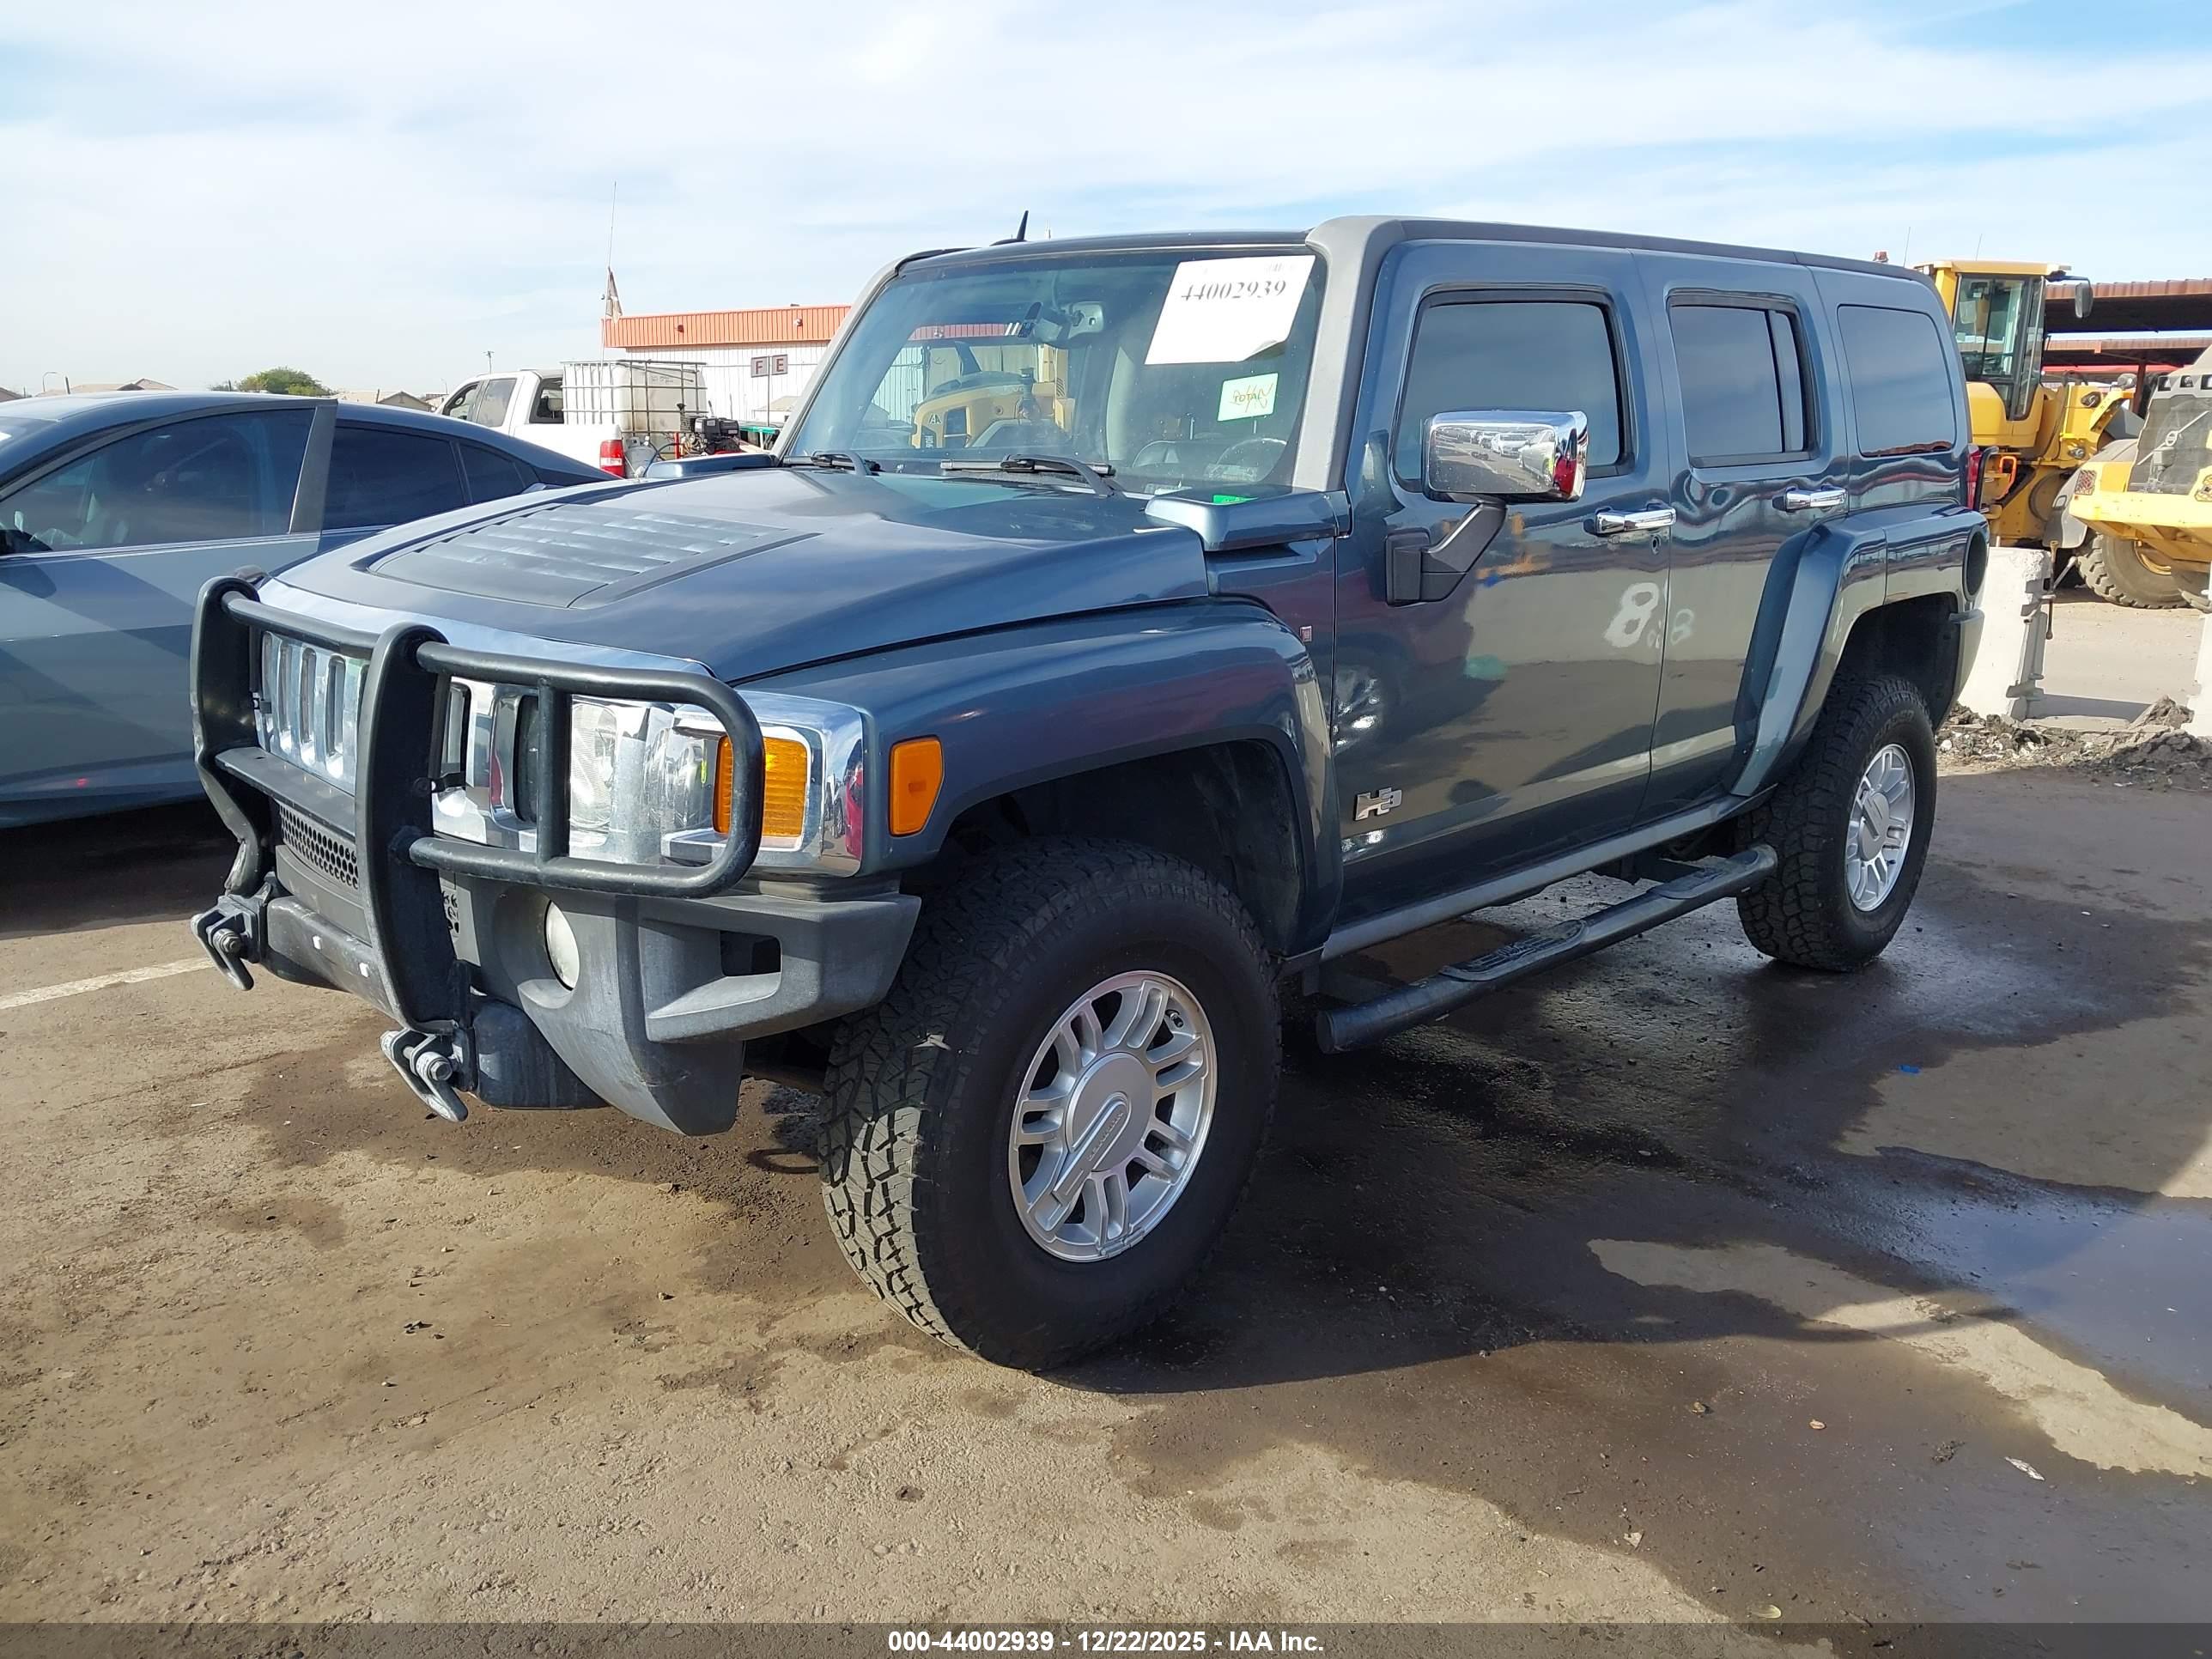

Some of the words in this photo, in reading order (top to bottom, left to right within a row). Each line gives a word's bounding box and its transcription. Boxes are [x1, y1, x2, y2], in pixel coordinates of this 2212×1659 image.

[1181, 280, 1286, 301] 44002939
[756, 360, 763, 374] F
[776, 357, 784, 373] E
[1602, 581, 1660, 648] 8
[1355, 787, 1403, 821] H3
